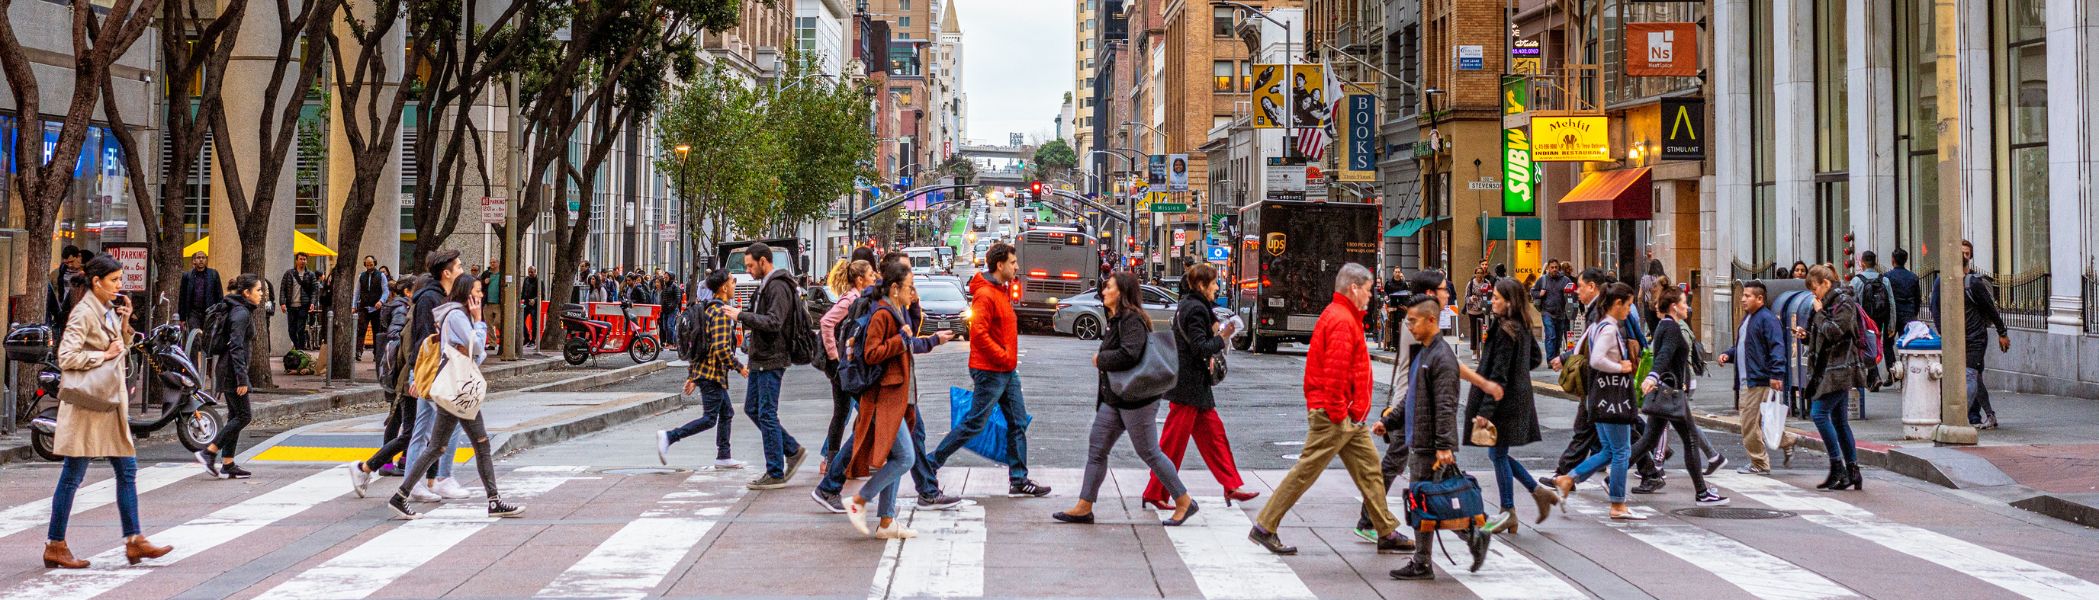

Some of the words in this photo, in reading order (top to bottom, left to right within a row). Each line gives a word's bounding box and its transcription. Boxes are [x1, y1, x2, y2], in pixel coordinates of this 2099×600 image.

[1651, 47, 1670, 59] Ns
[1356, 96, 1369, 169] BOOKS
[1507, 89, 1532, 202] SUBWY
[1071, 235, 1078, 243] 12
[1267, 238, 1285, 252] ups
[121, 250, 147, 259] PARKING
[1597, 375, 1630, 389] BIEN
[1597, 399, 1632, 414] FAIT
